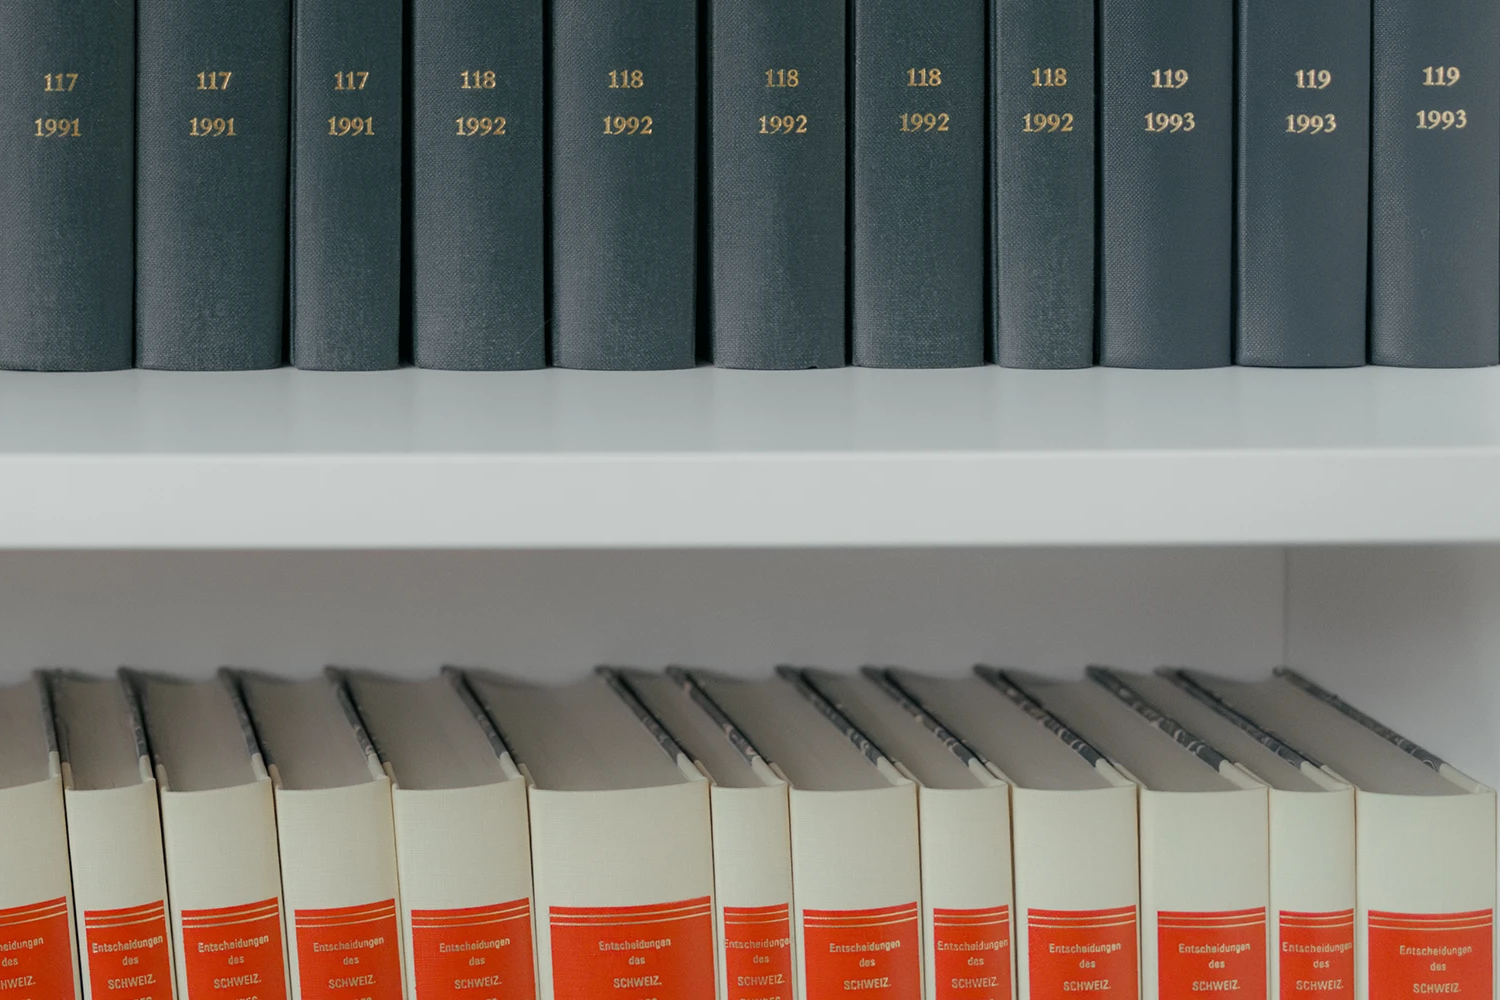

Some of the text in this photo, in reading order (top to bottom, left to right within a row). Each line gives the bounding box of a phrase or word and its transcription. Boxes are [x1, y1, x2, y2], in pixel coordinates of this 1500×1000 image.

[43, 72, 79, 92] 117
[196, 71, 233, 91] 117
[334, 70, 370, 91] 117
[460, 69, 497, 90] 118
[608, 69, 644, 89] 118
[765, 68, 800, 88] 118
[906, 67, 942, 87] 118
[1031, 67, 1068, 87] 118
[1151, 68, 1189, 89] 119
[1294, 68, 1332, 90] 119
[1422, 65, 1461, 87] 119
[34, 117, 82, 138] 1991
[189, 116, 237, 137] 1991
[327, 115, 375, 137] 1991
[455, 116, 507, 137] 1992
[603, 115, 654, 136] 1992
[758, 114, 808, 135] 1992
[899, 112, 950, 133] 1992
[1022, 112, 1074, 133] 1992
[1144, 111, 1196, 134] 1993
[1285, 113, 1337, 135] 1993
[1416, 108, 1468, 131] 1993
[92, 934, 164, 954] Entscheidungen
[197, 934, 270, 953] Entscheidungen
[312, 936, 385, 953] Entscheidungen
[439, 937, 511, 953] Entscheidungen
[598, 938, 672, 952] Entscheidungen
[829, 939, 901, 953] Entscheidungen
[937, 939, 1009, 952] Entscheidungen
[1048, 942, 1122, 954] Entscheidungen
[1178, 942, 1252, 955] Entscheidungen
[1282, 941, 1353, 953] Entscheidungen
[1399, 944, 1473, 957] Entscheidungen
[1, 956, 19, 968] des
[121, 955, 139, 966] des
[227, 954, 245, 966] des
[342, 956, 360, 966] des
[468, 956, 486, 967] des
[628, 955, 646, 966] des
[752, 954, 770, 964] des
[858, 957, 876, 968] des
[967, 956, 985, 966] des
[1078, 958, 1096, 969] des
[1208, 959, 1226, 969] des
[1312, 959, 1330, 969] des
[1429, 961, 1447, 972] des
[107, 973, 157, 990] SCHWEIZ.
[213, 973, 262, 990] SCHWEIZ.
[328, 974, 377, 990] SCHWEIZ.
[454, 974, 503, 990] SCHWEIZ.
[613, 975, 663, 989] SCHWEIZ.
[737, 973, 786, 987] SCHWEIZ.
[843, 976, 892, 991] SCHWEIZ.
[951, 975, 1000, 989] SCHWEIZ.
[1063, 978, 1112, 992] SCHWEIZ.
[1191, 979, 1241, 992] SCHWEIZ.
[1295, 978, 1344, 991] SCHWEIZ.
[1412, 982, 1462, 994] SCHWEIZ.
